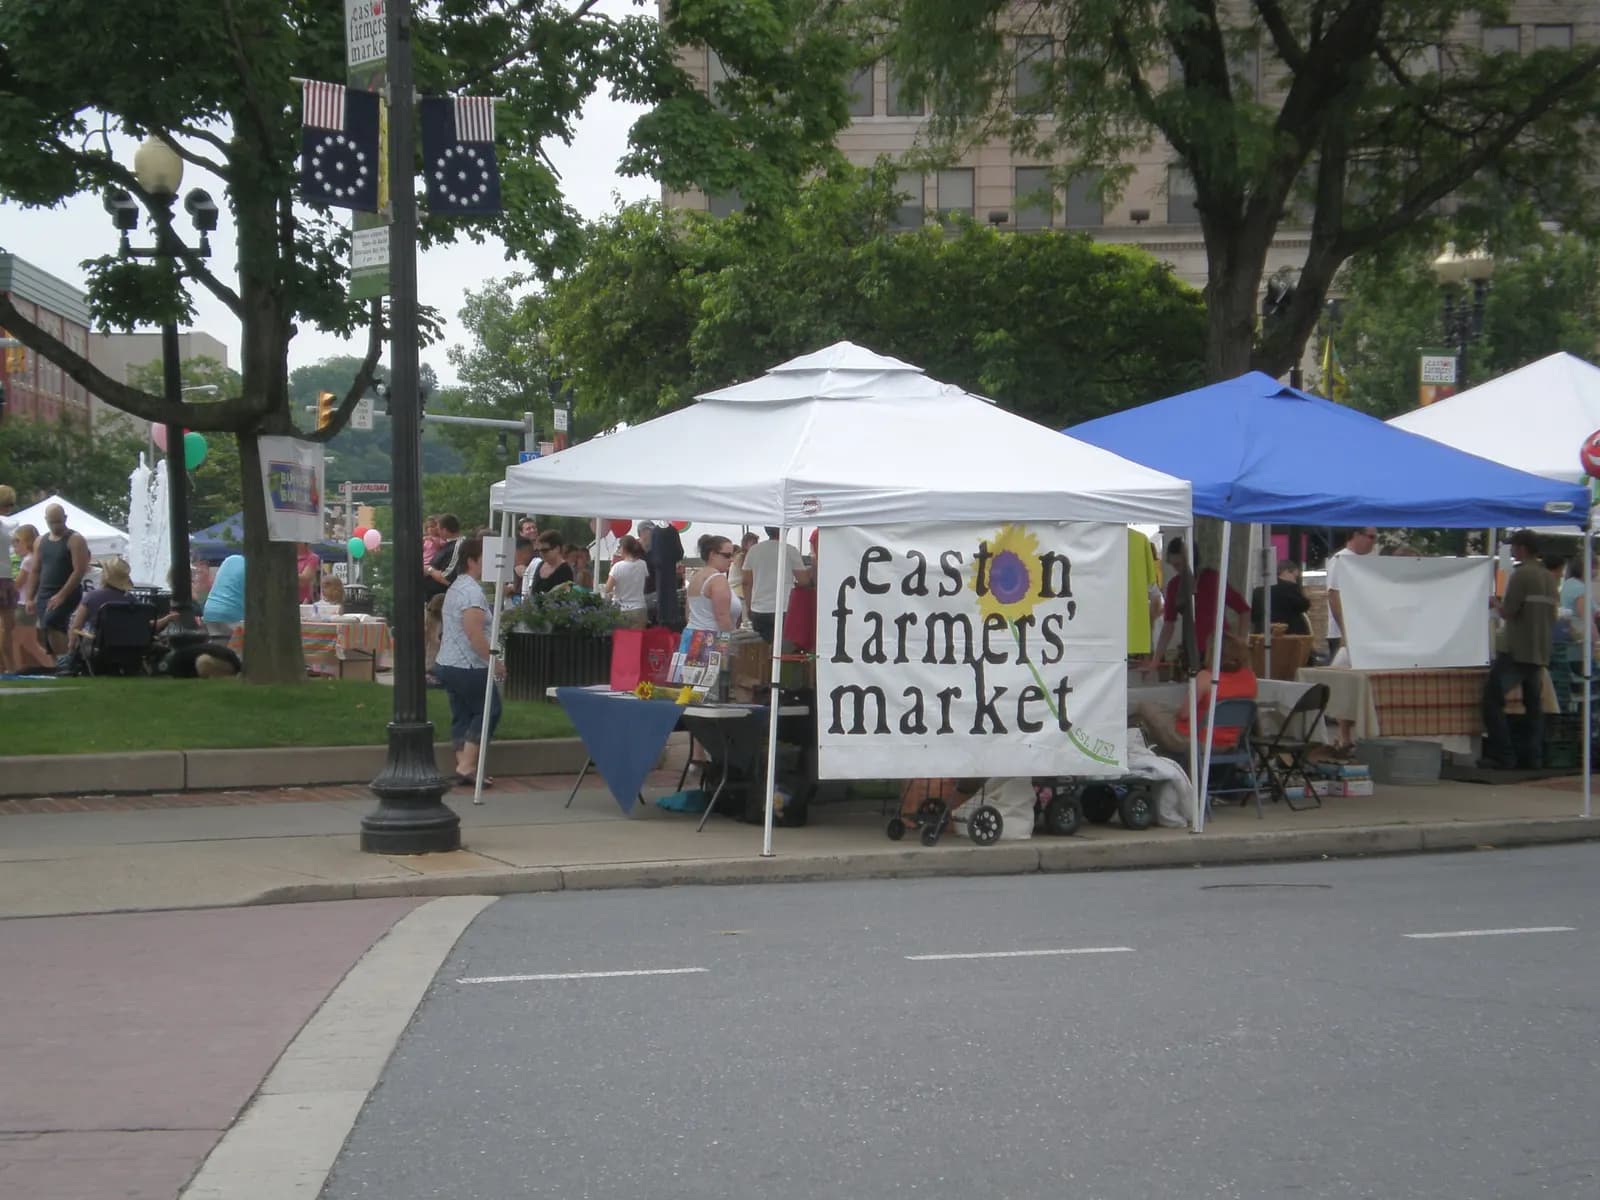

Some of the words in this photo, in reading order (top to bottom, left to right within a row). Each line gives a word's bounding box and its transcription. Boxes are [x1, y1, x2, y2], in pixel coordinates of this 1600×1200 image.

[352, 38, 385, 62] marke
[859, 541, 1073, 604] easton
[831, 576, 1076, 664] farmers'
[828, 657, 1073, 735] market
[1092, 736, 1116, 759] 1752
